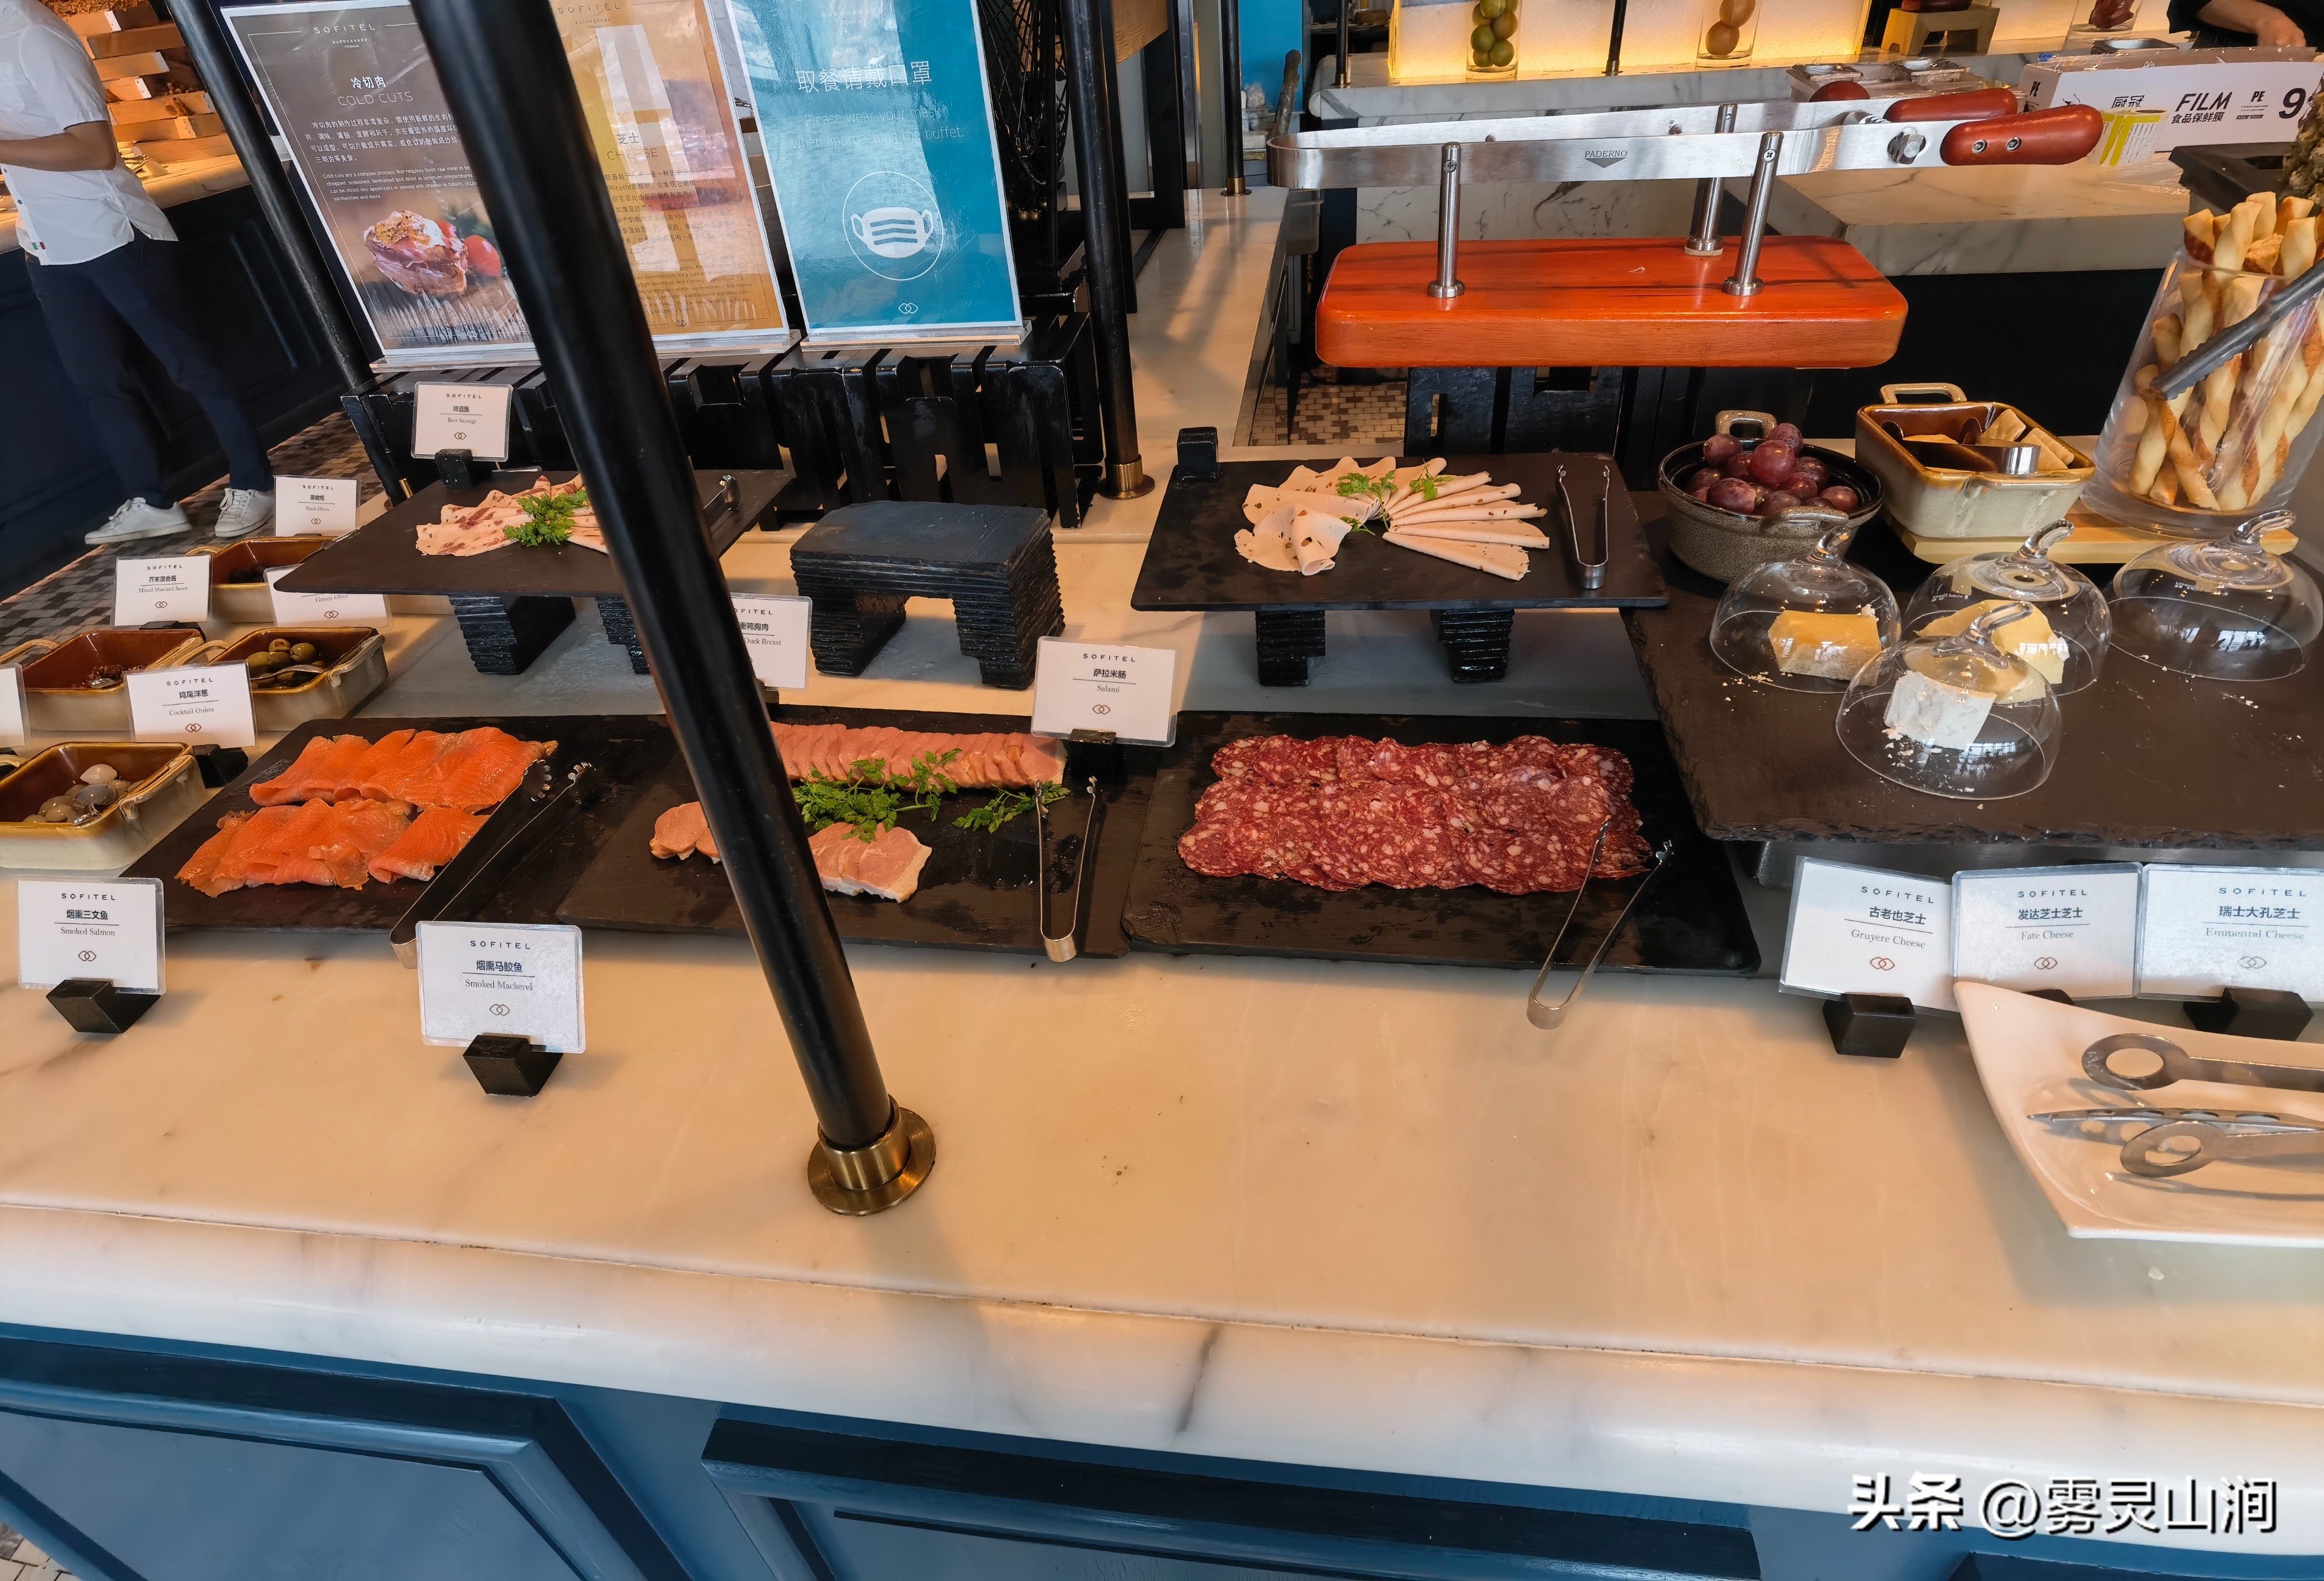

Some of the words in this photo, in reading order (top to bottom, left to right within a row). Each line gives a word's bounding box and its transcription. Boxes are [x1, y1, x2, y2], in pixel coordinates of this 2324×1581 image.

[558, 3, 621, 14] SOFITEL
[314, 24, 376, 34] SOFITEL
[350, 75, 386, 89] 冷切肉
[795, 60, 933, 94] 取餐请戴口罩
[337, 95, 374, 106] COLD
[378, 91, 413, 103] CUTS
[2175, 91, 2233, 112] FILM
[2250, 91, 2266, 102] PE
[804, 114, 842, 127] Please
[847, 112, 874, 123] wear
[879, 110, 905, 123] your
[910, 105, 943, 118] mask
[2171, 111, 2225, 124] 食品保鲜膜
[616, 132, 639, 144] 芝士
[790, 137, 822, 149] when
[827, 131, 898, 148] approaching
[901, 129, 921, 141] the
[925, 126, 964, 140] buffet.
[607, 149, 658, 160] CHEESE
[149, 575, 176, 583] 芥末混合酱
[740, 622, 769, 631] 熏鸭胸肉
[1083, 653, 1136, 663] SOFITEL
[1093, 669, 1127, 679] 萨拉米肠
[166, 677, 213, 686] SOFITEL
[179, 689, 208, 699] 鸡尾洋葱
[1097, 685, 1120, 693] Salami
[169, 708, 194, 716] Cocktail
[1861, 886, 1934, 904] SOFITEL
[2018, 889, 2087, 898] SOFITEL
[2219, 888, 2307, 896] SOFITEL
[66, 909, 109, 920] 烟熏三文鱼
[1869, 907, 1926, 925] 古老也芝士
[2018, 907, 2083, 920] 发达芝士芝士
[2219, 905, 2301, 919] 瑞士大孔芝士
[60, 927, 87, 935] Smoked
[2043, 930, 2074, 939] Cheese
[2206, 927, 2261, 938] Emmental
[2265, 930, 2305, 940] Cheese
[1851, 929, 1890, 943] Gruyere
[1893, 936, 1926, 948] Cheese
[470, 940, 531, 950] SOFITEL
[475, 960, 523, 972] 烟熏马鲛鱼
[465, 979, 495, 988] Smoked
[497, 981, 532, 991] Mackerel
